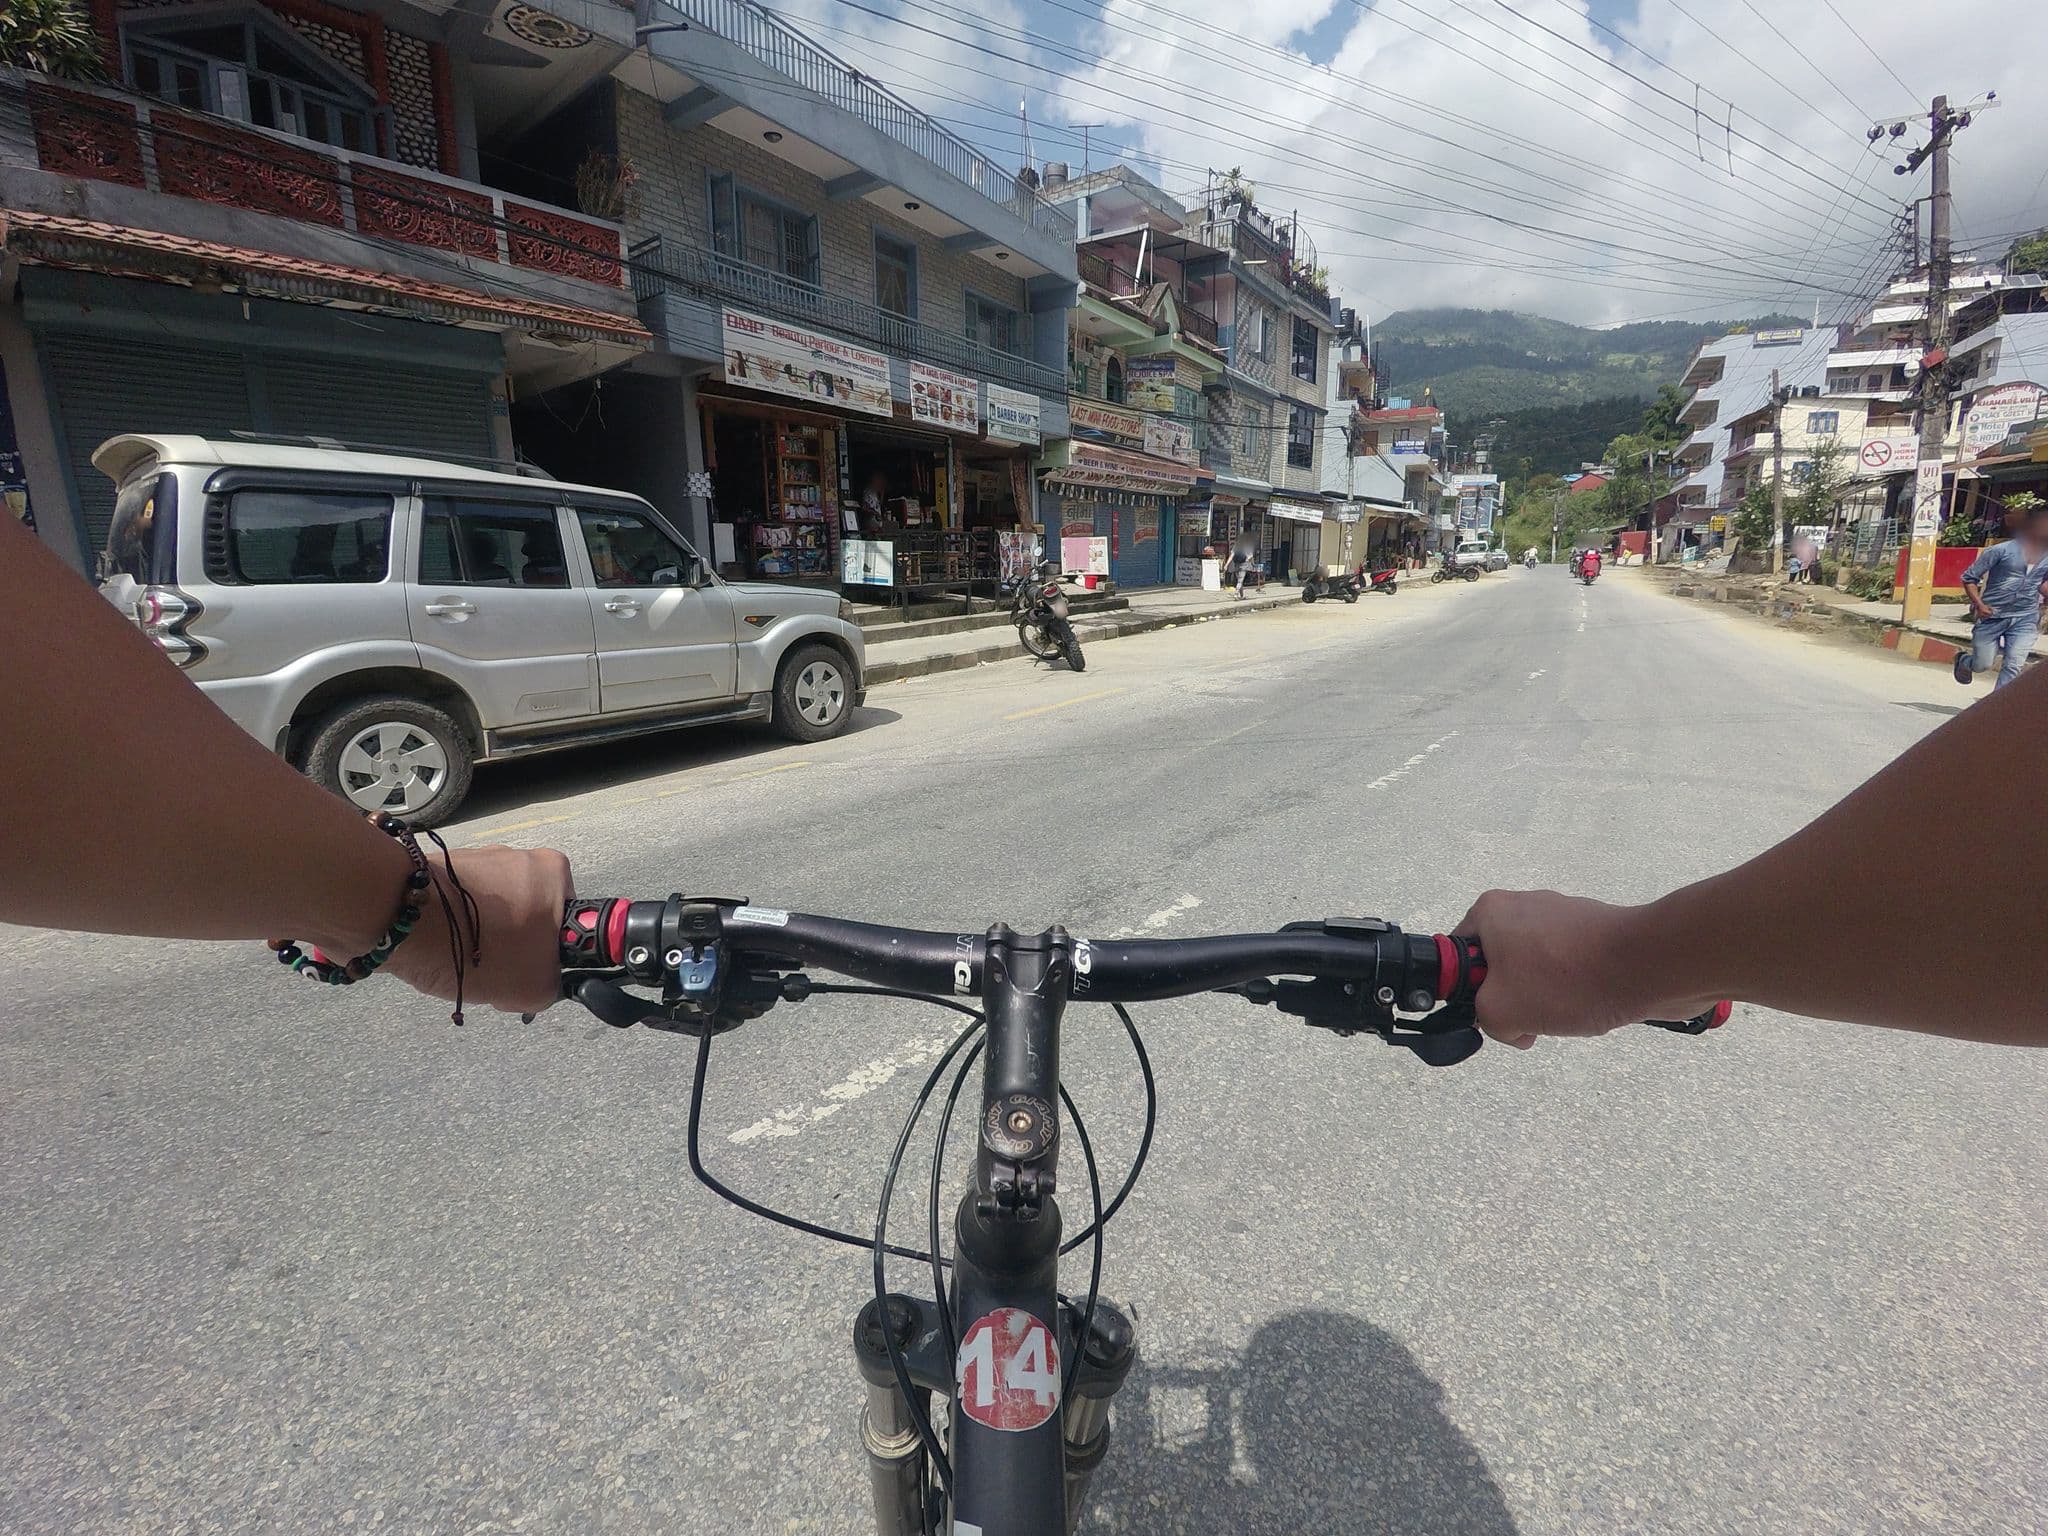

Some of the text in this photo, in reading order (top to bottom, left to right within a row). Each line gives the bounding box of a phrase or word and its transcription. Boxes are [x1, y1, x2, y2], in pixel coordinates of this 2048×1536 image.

[772, 325, 808, 348] Beauty
[808, 335, 841, 354] Parlour
[996, 403, 1032, 425] BARBER SHOP
[1071, 405, 1087, 421] LAST
[1102, 413, 1119, 429] FOOD
[1083, 458, 1098, 469] BEER
[1104, 462, 1119, 472] WINE
[1010, 1094, 1055, 1146] GIANT
[957, 1326, 1058, 1408] 14
